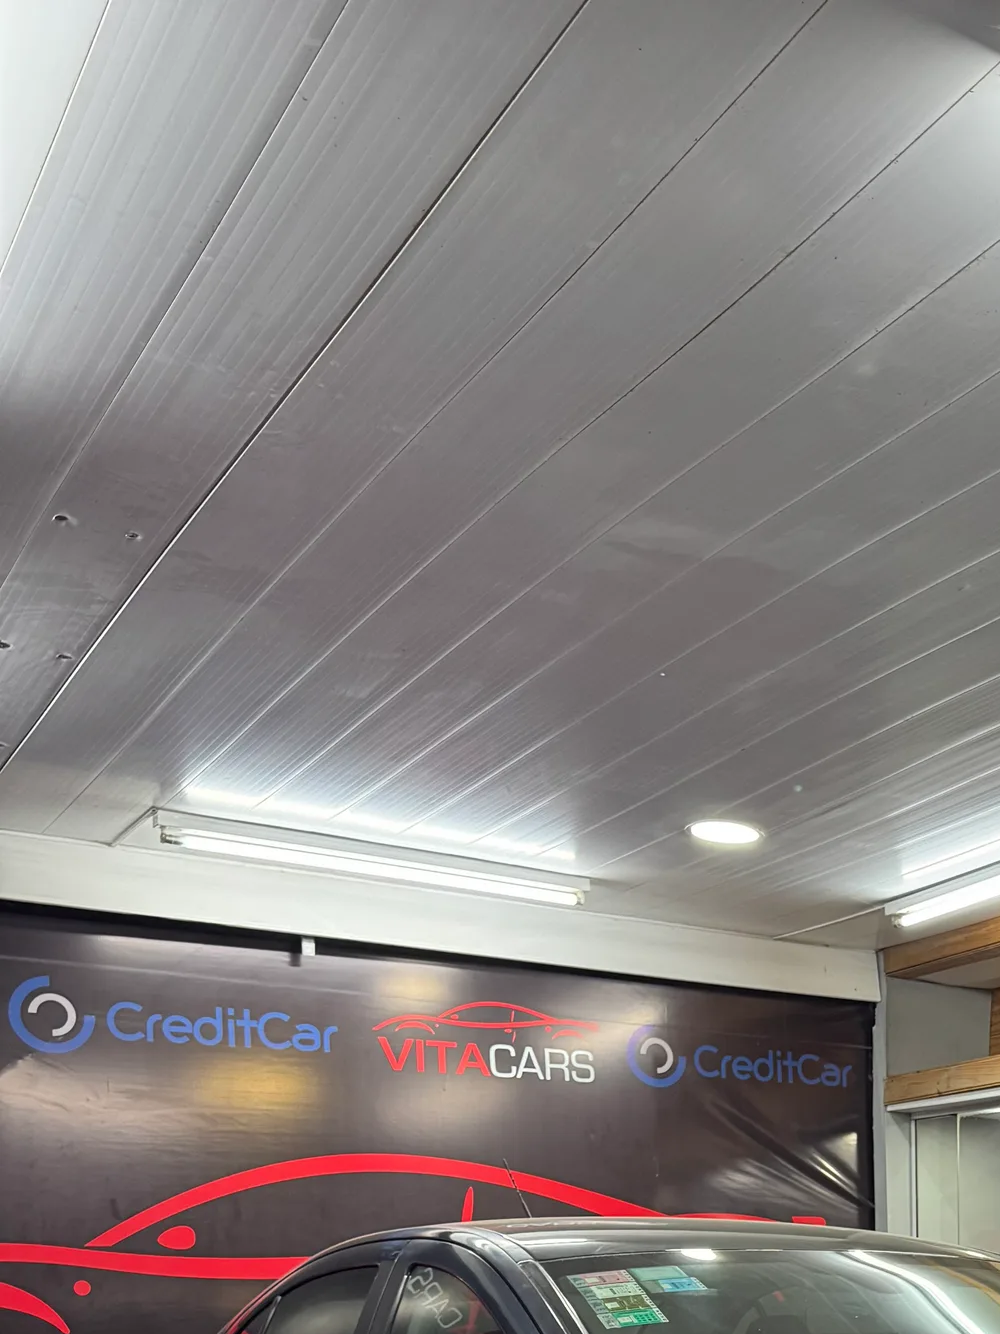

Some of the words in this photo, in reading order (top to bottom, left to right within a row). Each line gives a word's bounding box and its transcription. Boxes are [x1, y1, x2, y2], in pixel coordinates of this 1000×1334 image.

[107, 1002, 338, 1053] CreditCar
[377, 1036, 595, 1083] VITACARS
[693, 1045, 852, 1088] CreditCar
